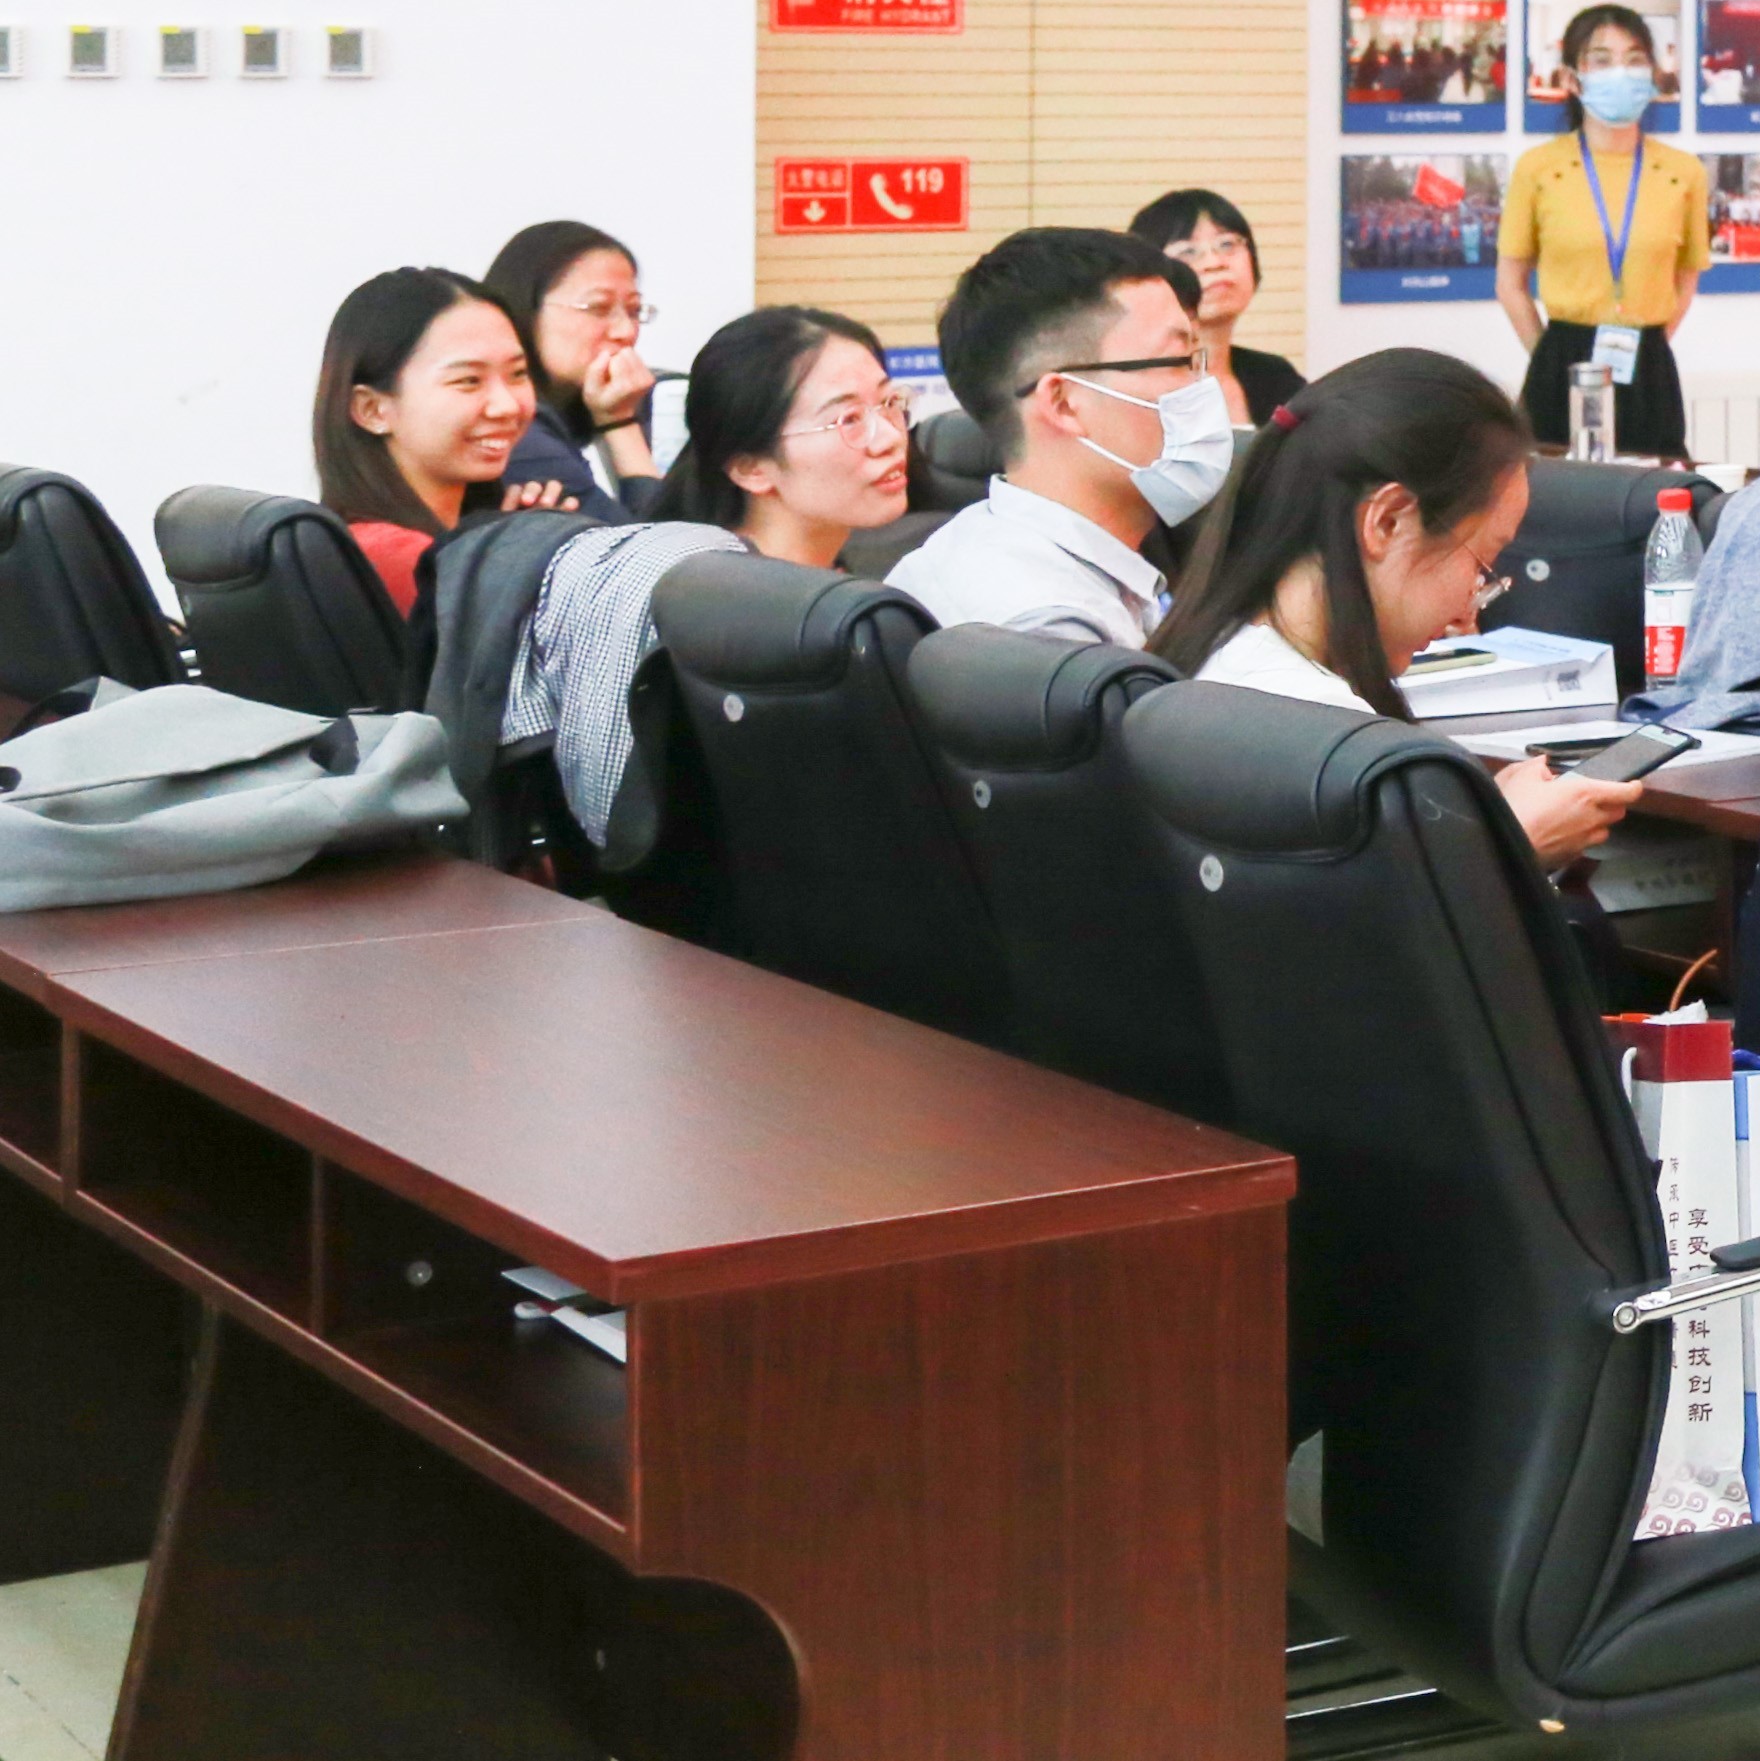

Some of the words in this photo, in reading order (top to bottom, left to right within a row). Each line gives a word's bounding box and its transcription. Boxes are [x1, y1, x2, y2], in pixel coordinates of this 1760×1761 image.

[900, 167, 944, 194] 119
[1687, 1207, 1713, 1423] 享受科技创新
